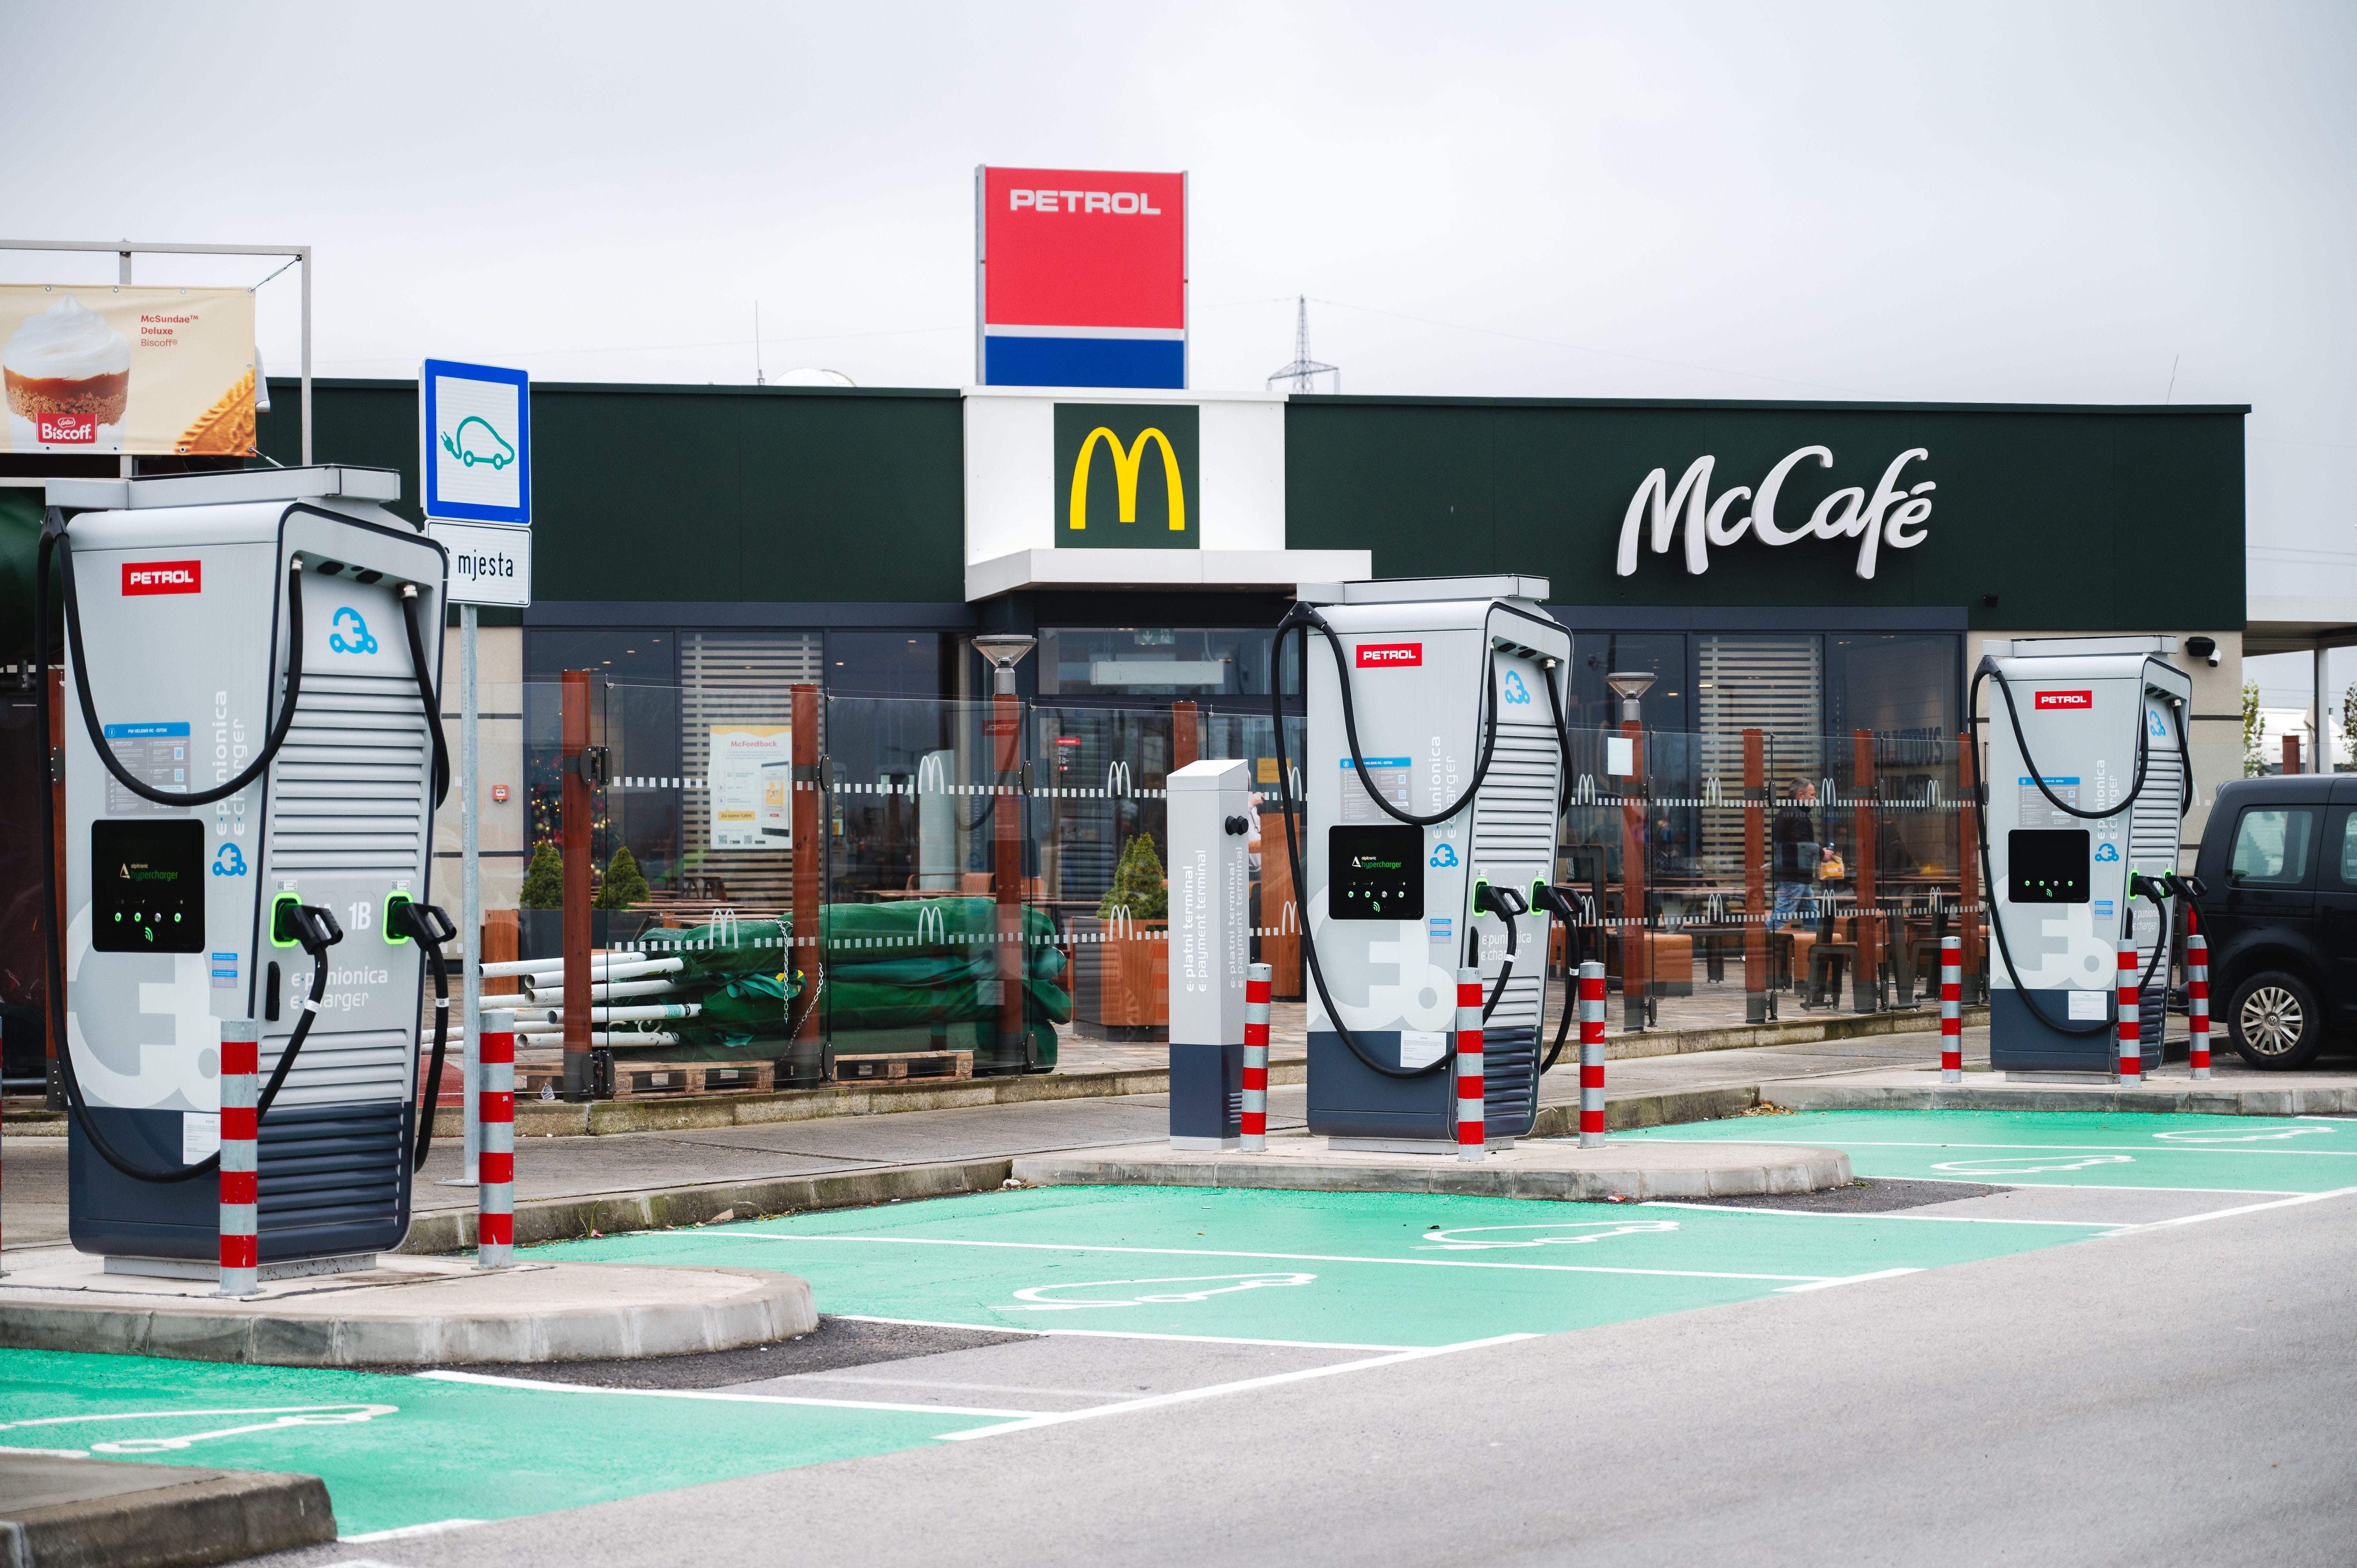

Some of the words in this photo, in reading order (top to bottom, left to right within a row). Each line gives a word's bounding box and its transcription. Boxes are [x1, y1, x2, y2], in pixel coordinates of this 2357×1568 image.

[1010, 189, 1161, 214] PETROL
[141, 327, 173, 335] Deluxe
[1617, 445, 1936, 579] McCafé
[458, 549, 513, 581] mjesta
[130, 569, 194, 585] PETROL
[1363, 649, 1416, 660] PETROL
[2041, 695, 2087, 704] PETROL
[1361, 861, 1402, 869] hypercharger
[131, 870, 178, 881] hypercharger
[1195, 850, 1206, 910] terminal
[1182, 866, 1193, 929] terminal
[348, 901, 371, 930] 1B
